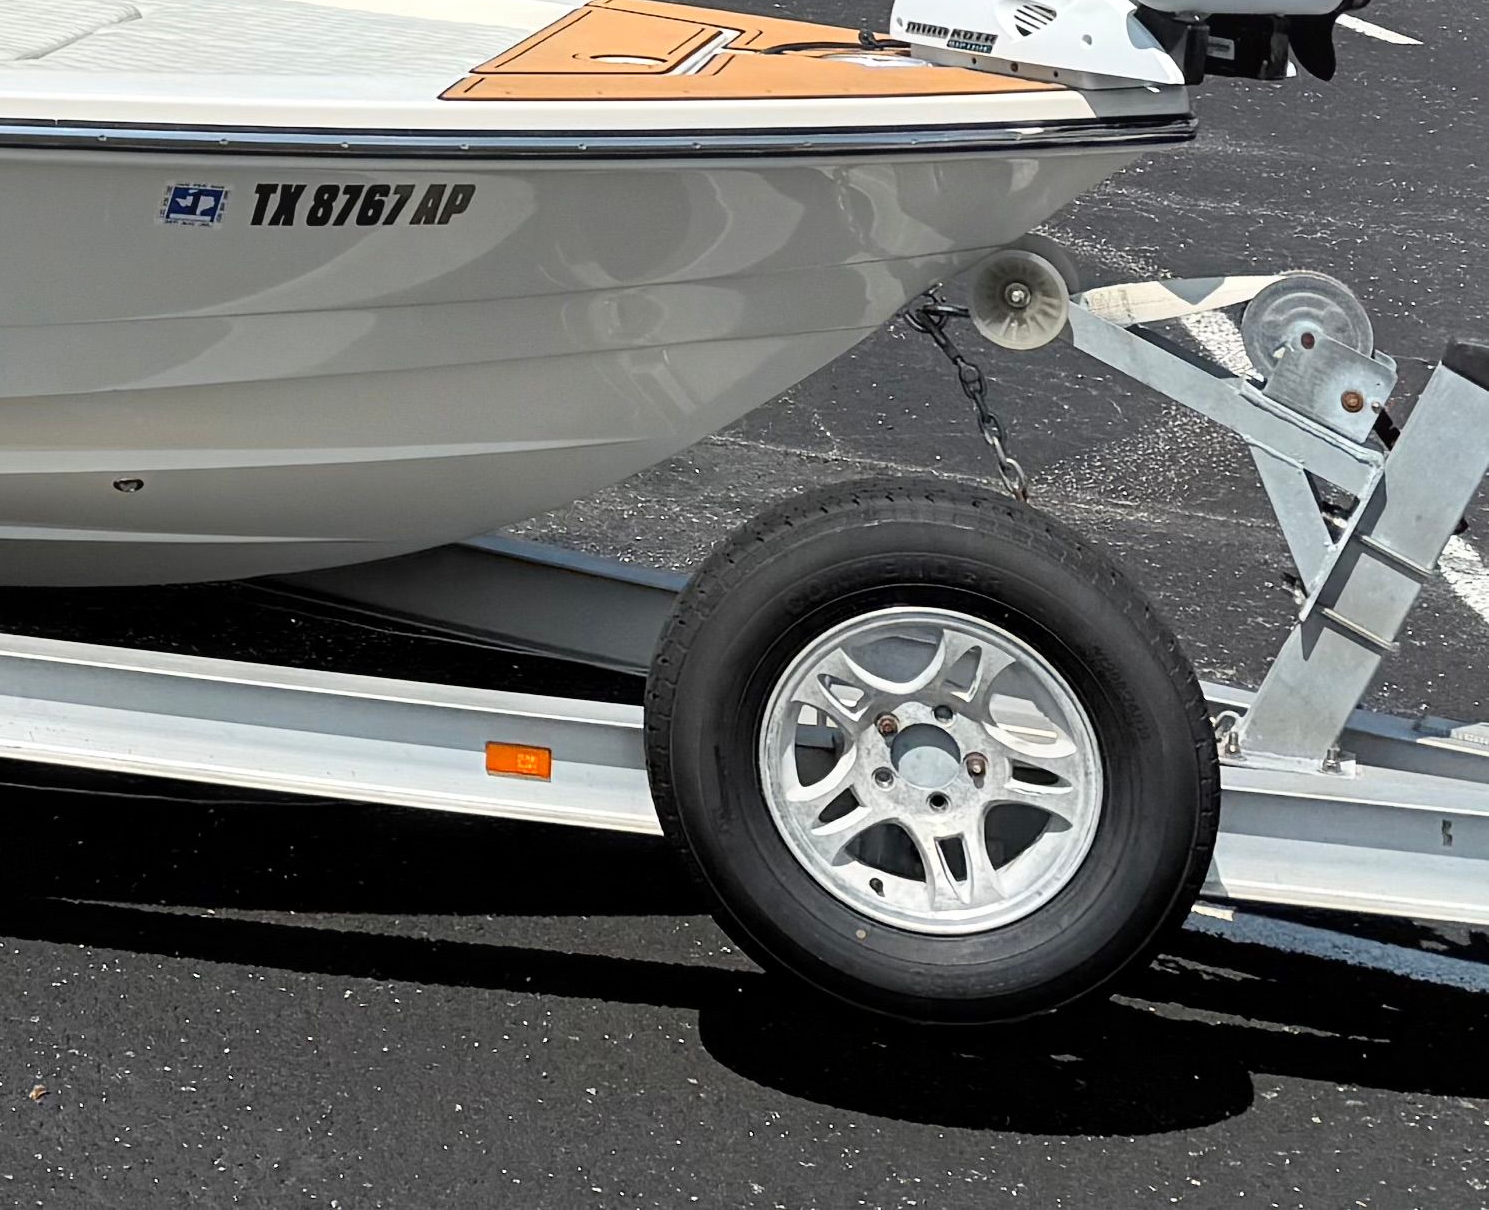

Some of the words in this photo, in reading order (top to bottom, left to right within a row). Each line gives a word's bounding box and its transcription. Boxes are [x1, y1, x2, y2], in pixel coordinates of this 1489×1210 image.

[250, 183, 307, 226] TX
[305, 183, 415, 227] 8767
[409, 183, 476, 226] AP
